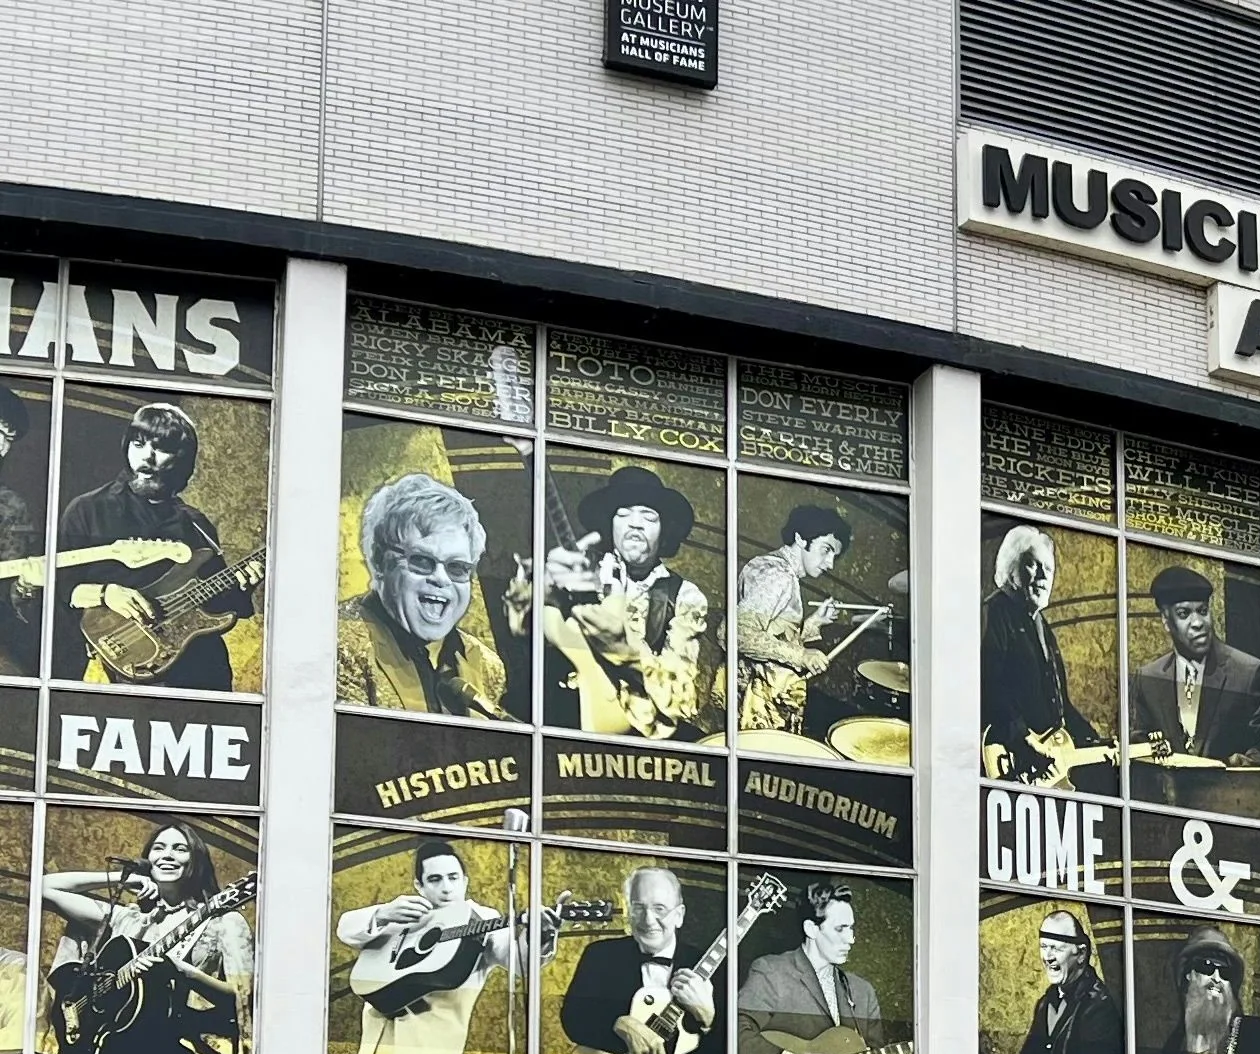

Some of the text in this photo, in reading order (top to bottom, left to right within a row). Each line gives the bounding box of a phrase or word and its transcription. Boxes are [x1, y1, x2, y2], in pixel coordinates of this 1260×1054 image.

[621, 9, 705, 39] GALLERY
[621, 32, 705, 58] AT MUSICIANS
[621, 45, 705, 71] HALL OF FAME
[351, 306, 531, 348] ALABAMA
[352, 333, 531, 374] RICKY SKAGGS
[551, 351, 655, 386] TOTO
[349, 378, 434, 400] SIGMA
[352, 360, 531, 402] DON FELDER
[550, 374, 662, 400] CORKI CASEY
[656, 369, 724, 386] CHARLIE
[657, 380, 723, 398] DANIELS
[550, 398, 723, 434] RANDY BACHMAN
[741, 387, 903, 428] DON EVERLY
[549, 410, 723, 452] BILLY COX
[740, 425, 903, 463] GARTH & THE
[742, 410, 902, 444] STEVE WARINER
[1051, 432, 1110, 456] EDDY
[740, 441, 833, 468] BROOKS
[1124, 448, 1180, 469] CHET
[1185, 462, 1260, 488] ATKINS
[982, 452, 1112, 495] RICKETS
[1124, 463, 1200, 492] WILL
[1207, 481, 1260, 506] LEE
[1012, 479, 1111, 510] WRECKING
[1126, 483, 1176, 501] BILLY
[1125, 497, 1260, 535] THE MUSCLE
[57, 714, 251, 781] FAME
[375, 752, 898, 839] HISTORIC MUNICIPAL AUDITORIUM
[986, 789, 1105, 896] COME
[1168, 819, 1251, 914] &
